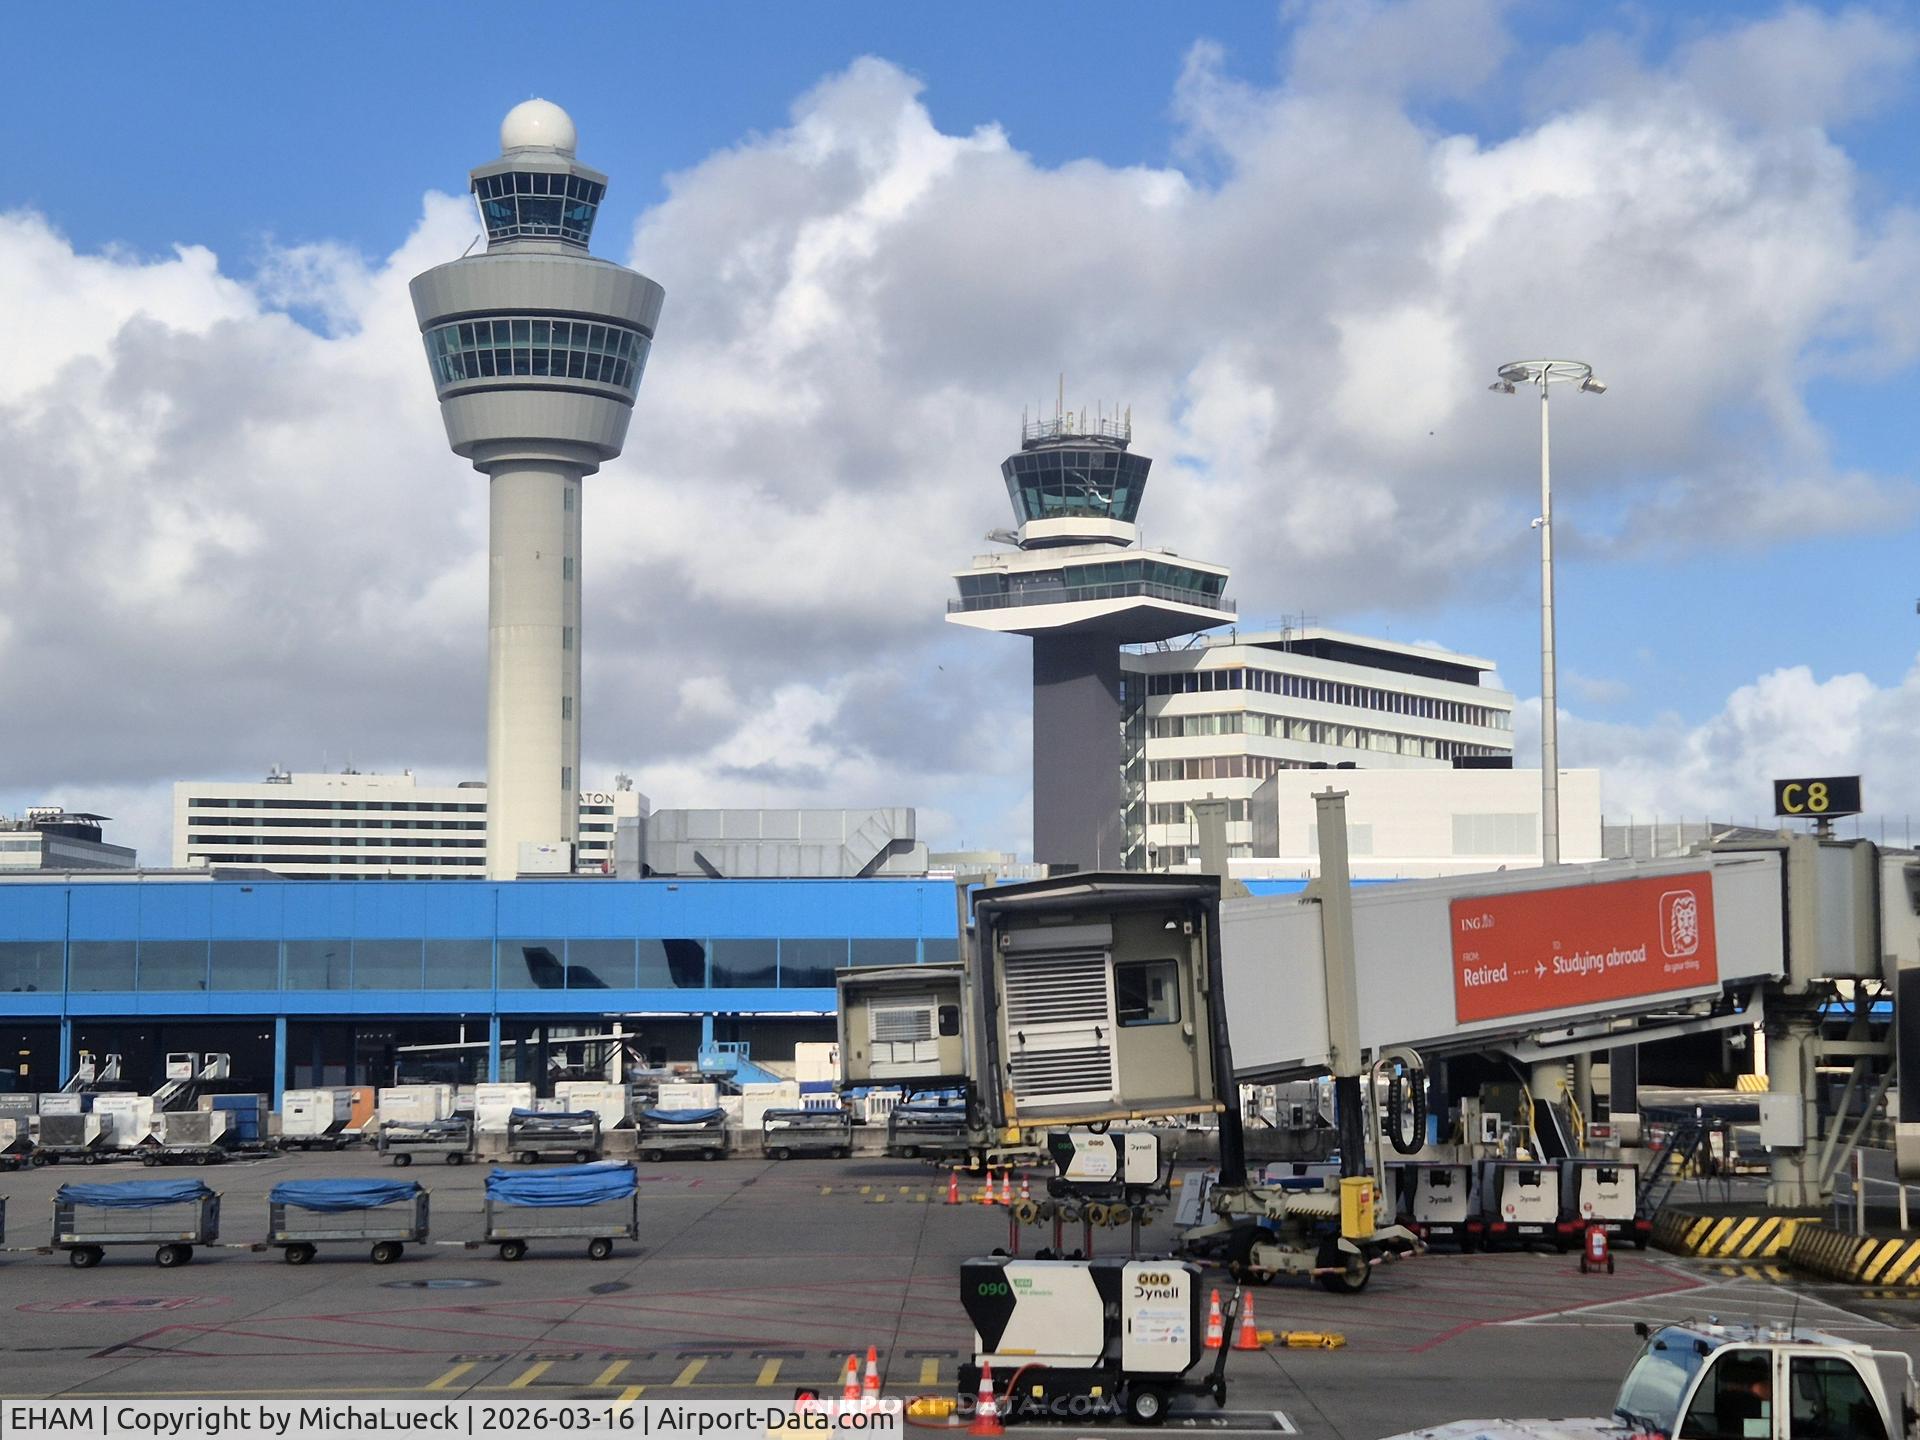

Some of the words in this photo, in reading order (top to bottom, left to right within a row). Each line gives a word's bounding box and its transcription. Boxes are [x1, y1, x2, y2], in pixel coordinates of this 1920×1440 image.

[1782, 782, 1829, 813] C8
[1461, 918, 1481, 931] ING
[1553, 950, 1604, 976] Studying
[1606, 944, 1647, 967] abroad
[1463, 962, 1508, 987] Retired
[978, 1282, 1008, 1296] 090
[1134, 1286, 1179, 1301] Dynell
